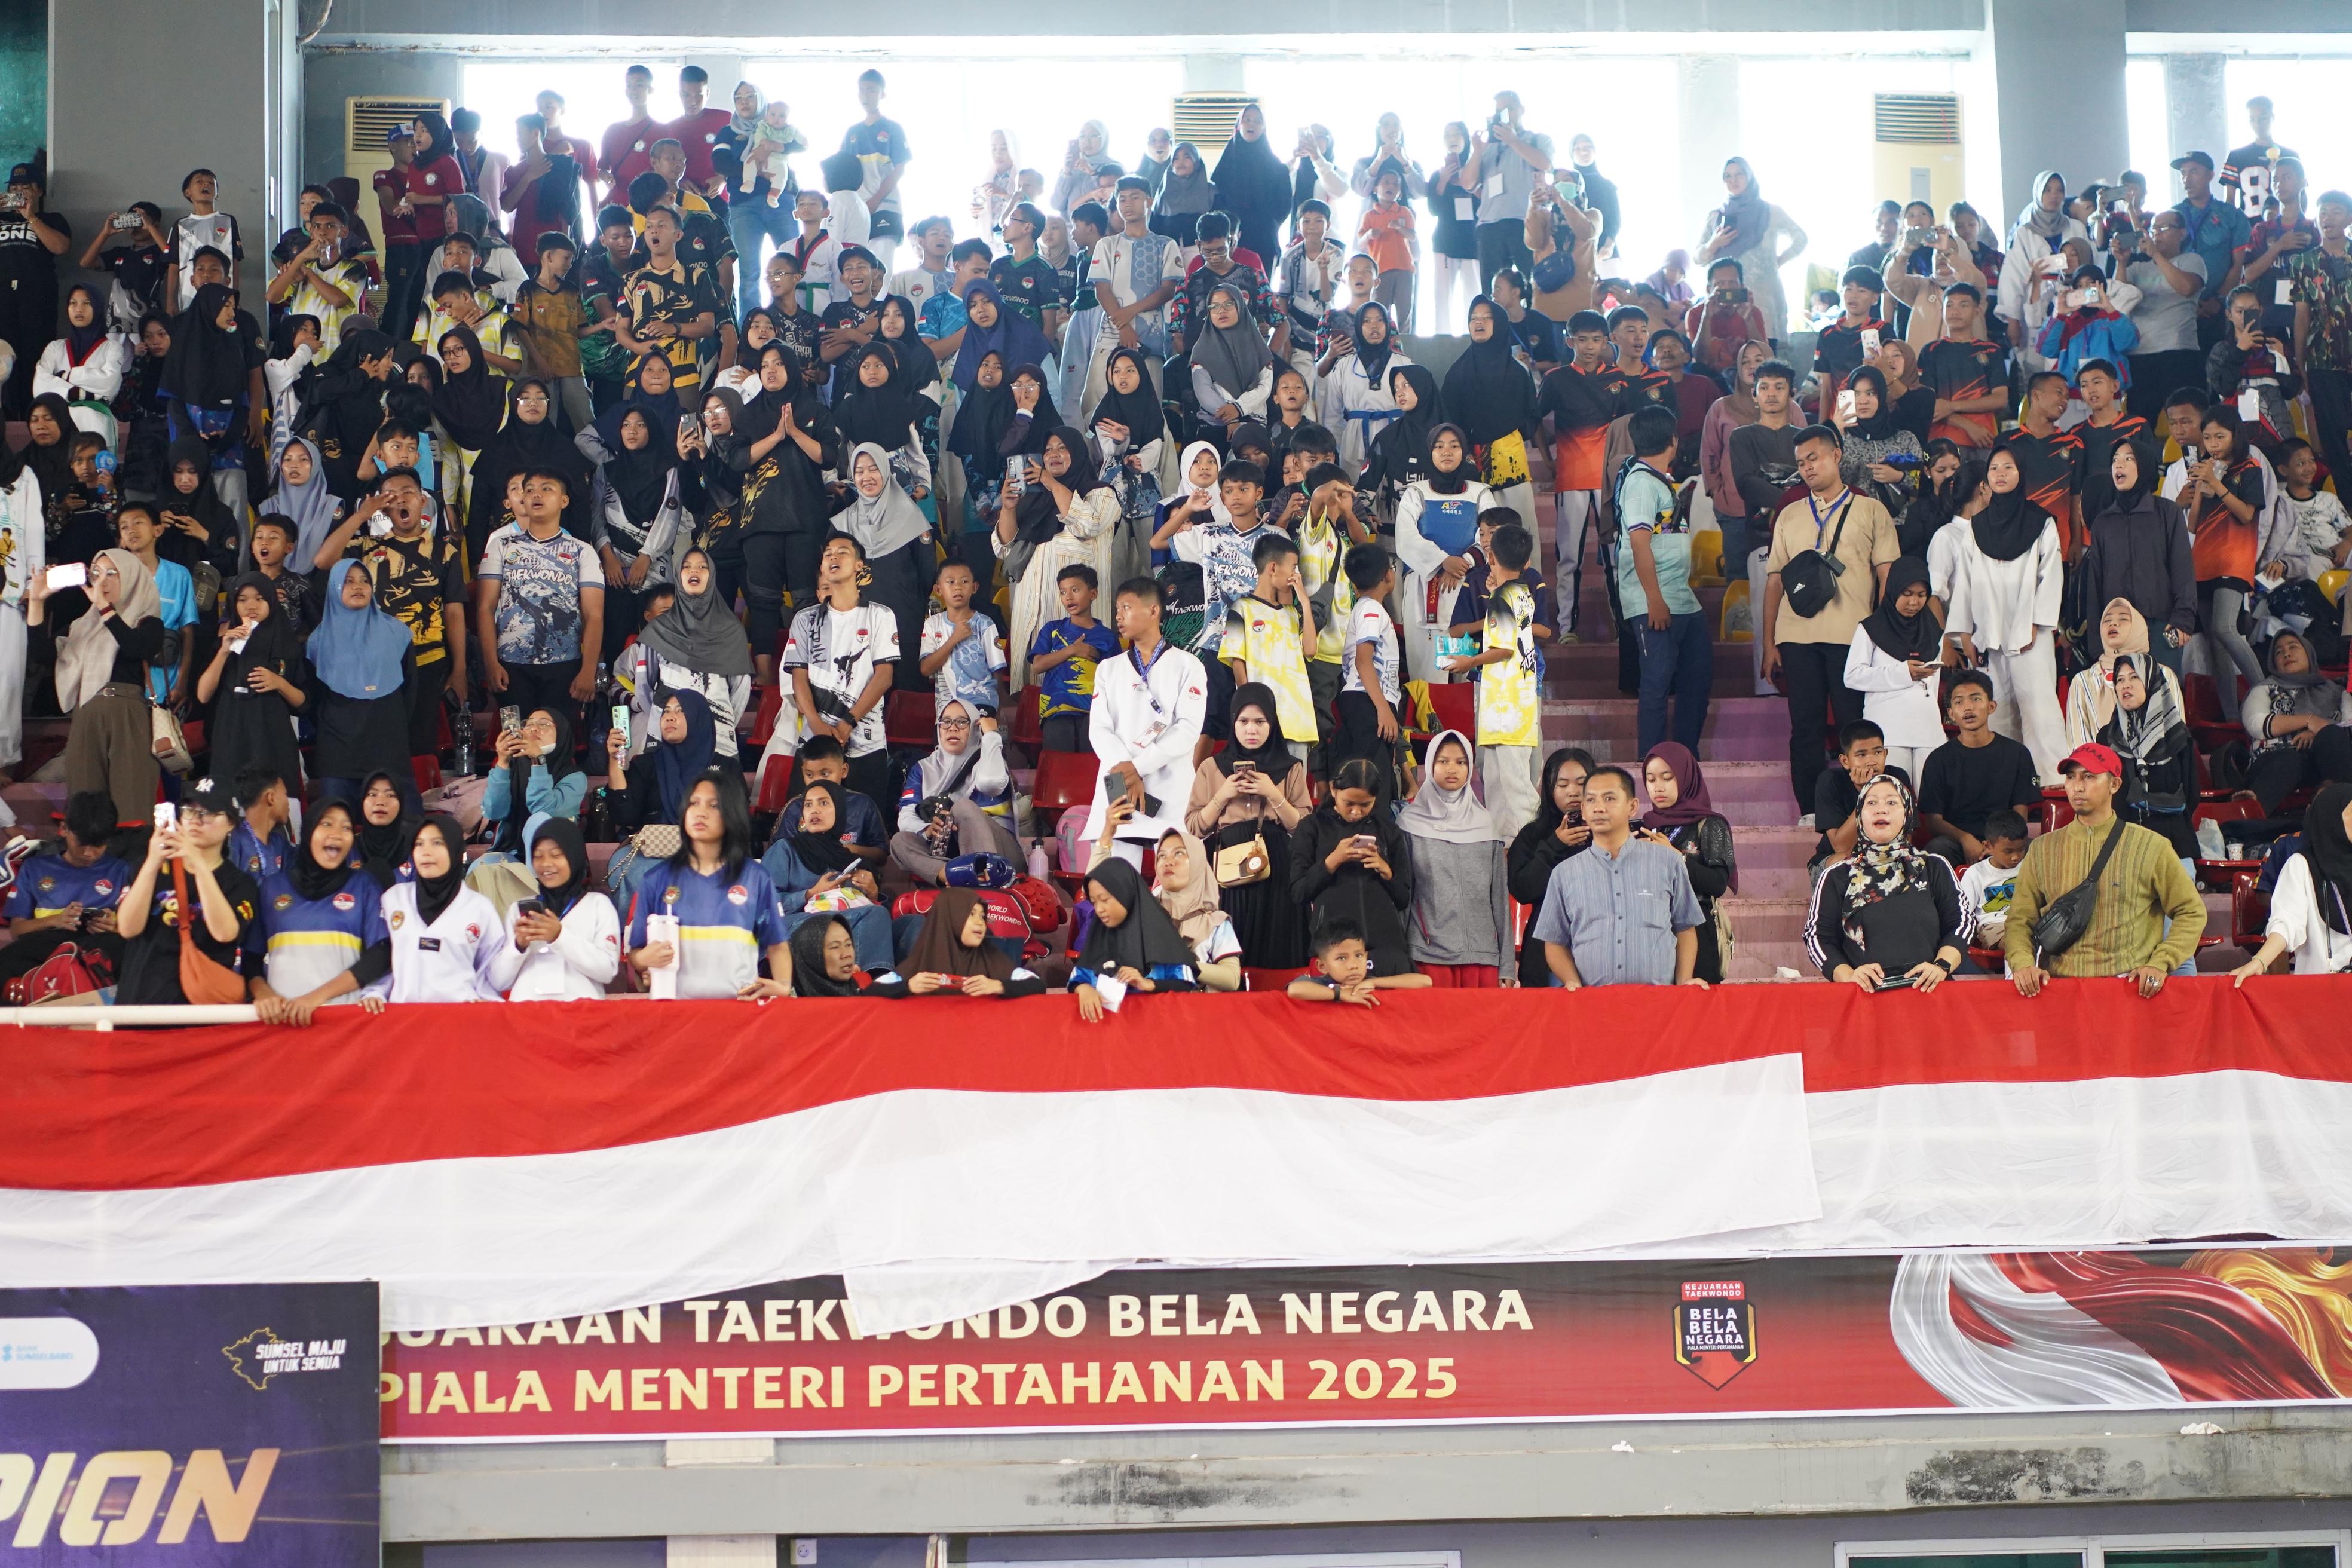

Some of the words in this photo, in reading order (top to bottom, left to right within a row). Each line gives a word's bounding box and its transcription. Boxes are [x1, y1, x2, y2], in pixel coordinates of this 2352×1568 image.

[506, 568, 572, 584] TAEKWONDO
[1175, 604, 1205, 614] TAEKWO
[987, 912, 1022, 926] AEKWONDO
[1110, 1294, 1261, 1336] BELA
[1279, 1289, 1534, 1333] NEGARA
[1690, 1307, 1737, 1320] BELA
[1690, 1321, 1738, 1334] BELA
[1685, 1334, 1744, 1345] NEGARA
[255, 1342, 305, 1359] SUMSEL
[308, 1339, 347, 1356] MAJU
[263, 1358, 301, 1373] UNTUK
[301, 1355, 341, 1371] SEMUA
[574, 1365, 844, 1411] MENTERI
[868, 1359, 1284, 1407] PERTAHANAN
[1307, 1358, 1457, 1399] 2025
